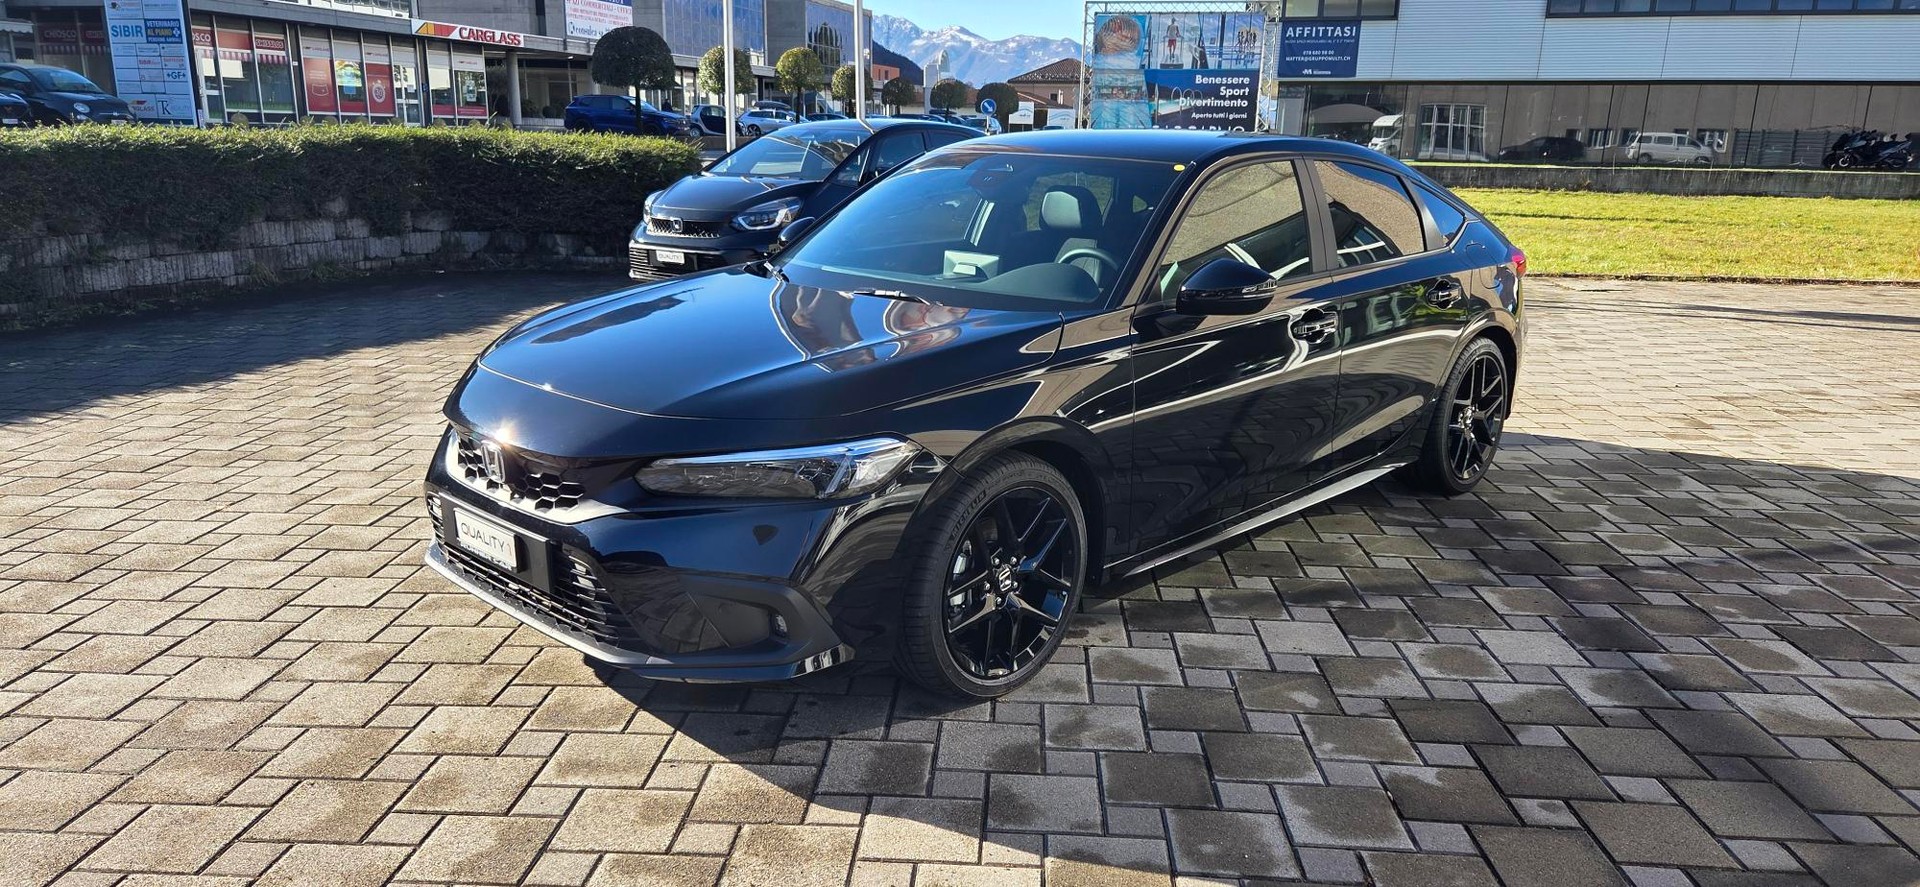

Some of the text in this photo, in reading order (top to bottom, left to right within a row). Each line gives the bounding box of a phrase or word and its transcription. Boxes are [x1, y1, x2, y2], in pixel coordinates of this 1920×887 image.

[44, 29, 77, 38] CHIOSCO
[111, 25, 143, 38] SIBIR
[458, 27, 522, 46] CARGLASS
[1286, 26, 1356, 37] AFFITTASI
[1195, 74, 1250, 84] Benessere
[1219, 86, 1250, 98] Sport
[1179, 97, 1249, 107] Divertimento
[1228, 112, 1248, 120] giorni
